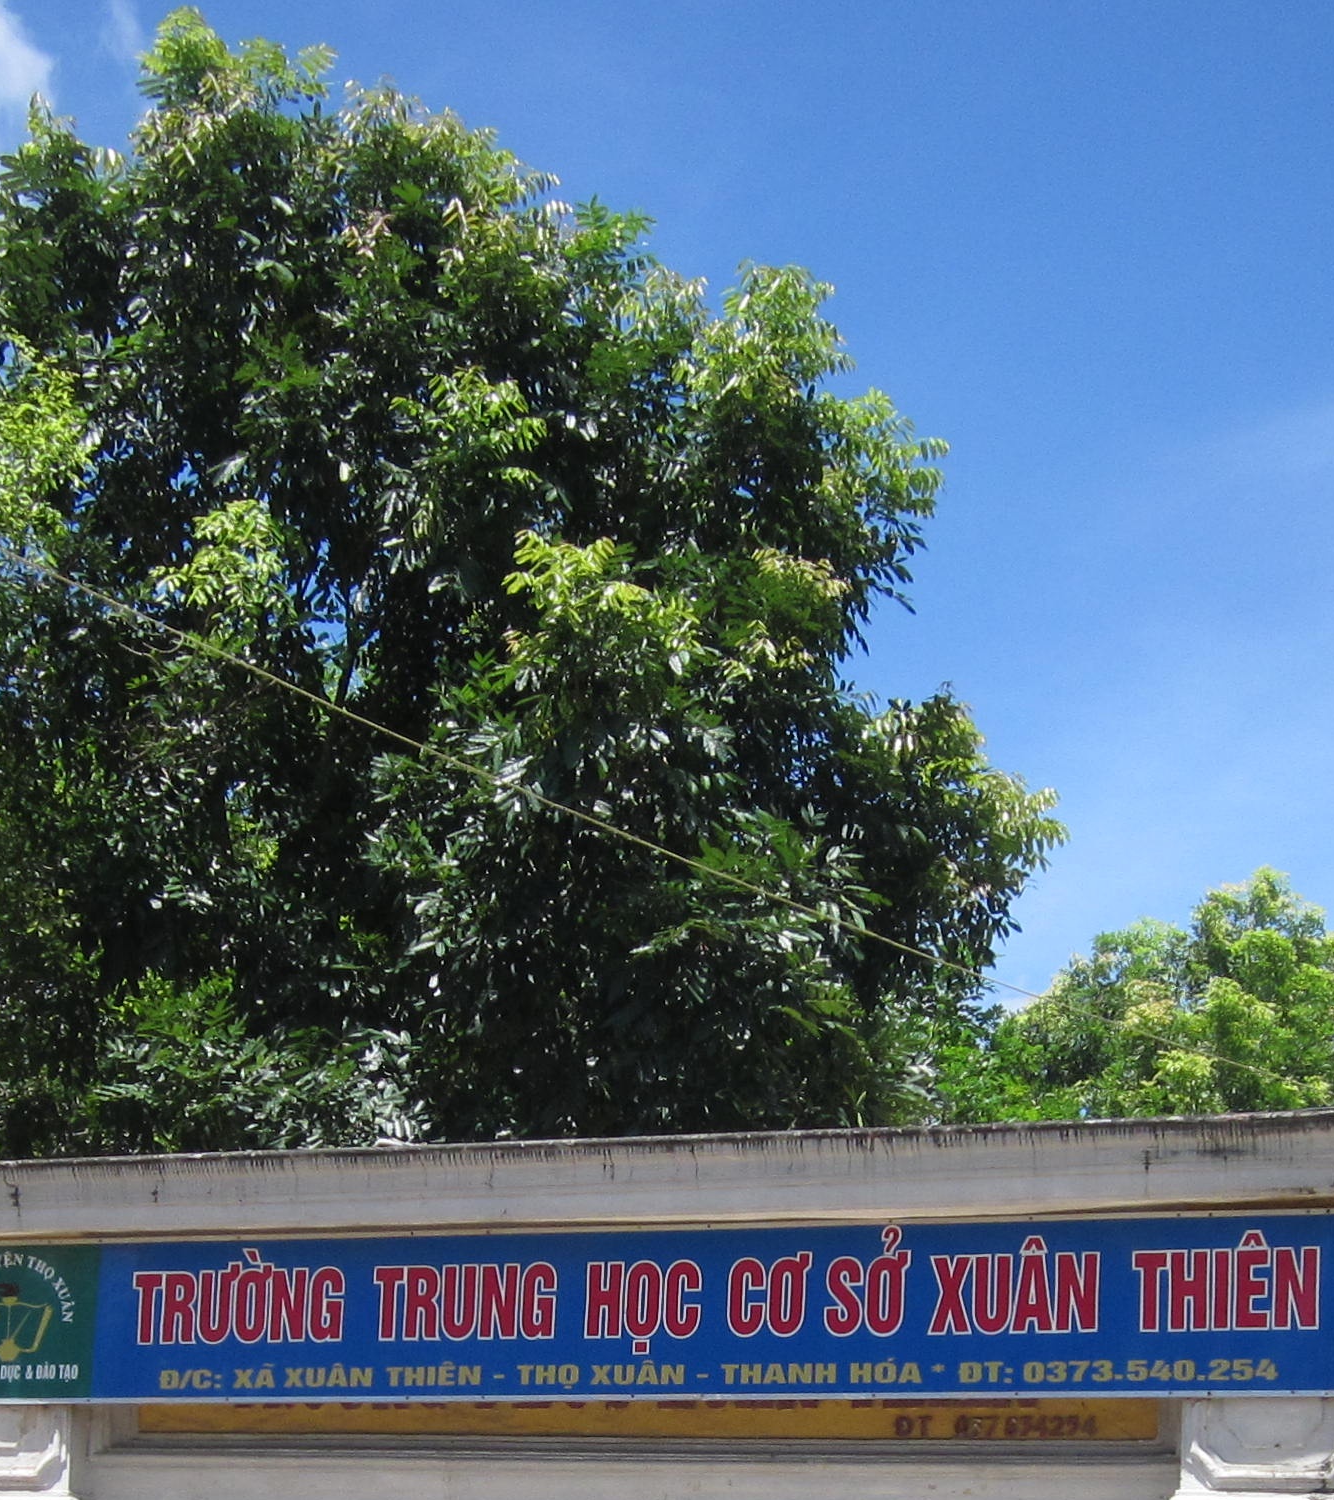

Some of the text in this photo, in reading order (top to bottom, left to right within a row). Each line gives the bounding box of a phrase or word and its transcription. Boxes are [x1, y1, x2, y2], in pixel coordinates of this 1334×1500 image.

[51, 1277, 75, 1323] XUÂN
[133, 1225, 1320, 1355] TRƯỜNG TRUNG HỌC CƠ SỞ XUÂN THIÊN
[0, 1364, 21, 1383] DỤC
[25, 1364, 33, 1380] &
[59, 1363, 79, 1383] TẠO
[159, 1369, 222, 1389] Đ/C:
[232, 1363, 275, 1389] XÃ
[283, 1362, 374, 1388] XUÂN
[386, 1361, 482, 1387] THIÊN
[517, 1364, 580, 1389] THỌ
[590, 1360, 685, 1385] XUÂN
[721, 1363, 837, 1385] THANH
[849, 1357, 922, 1384] HÓA
[958, 1361, 1013, 1384] ĐT:
[1023, 1359, 1278, 1384] 0373.540.254
